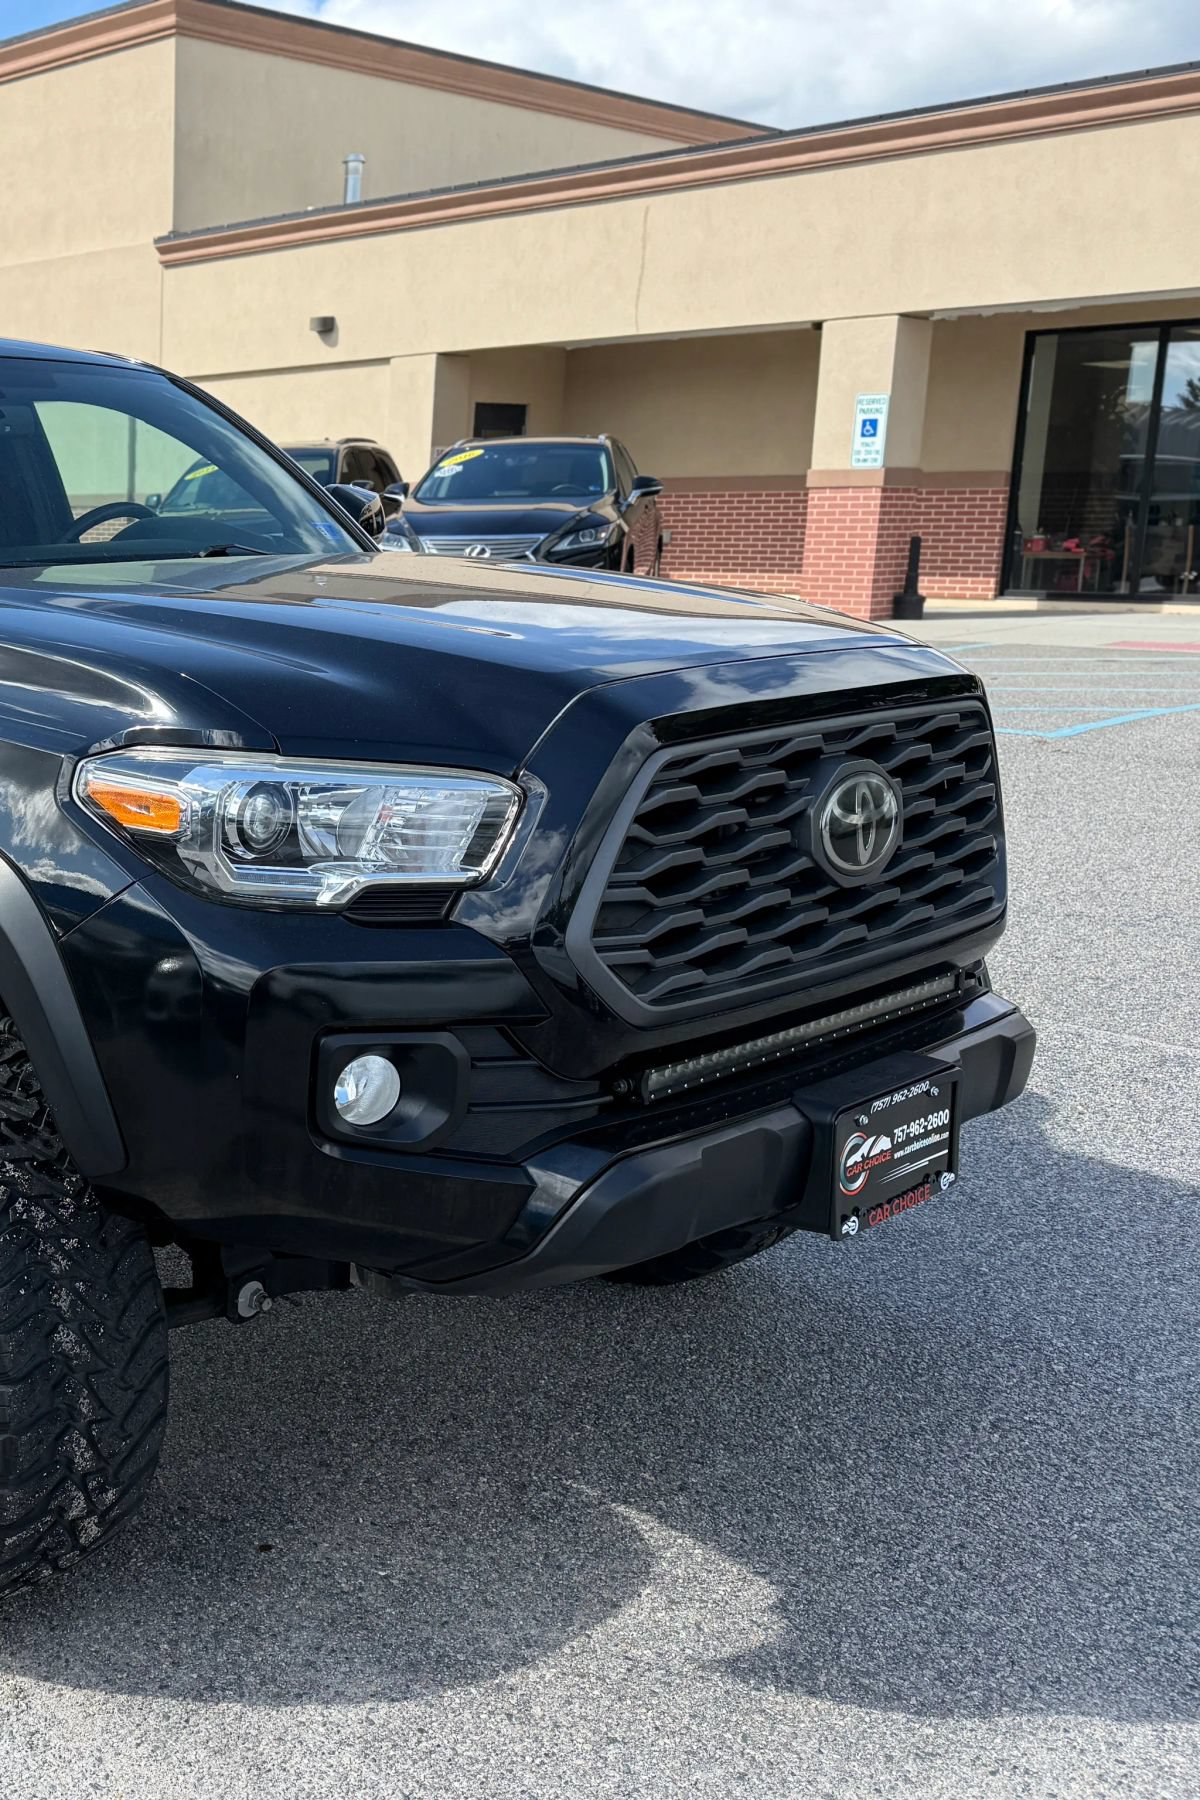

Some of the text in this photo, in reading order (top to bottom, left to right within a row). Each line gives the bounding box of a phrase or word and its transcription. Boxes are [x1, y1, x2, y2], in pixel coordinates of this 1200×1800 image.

[858, 407, 884, 415] PARKING
[870, 1081, 930, 1114] (757) 962-2600
[893, 1108, 950, 1145] 757-962-2600
[893, 1131, 950, 1160] www.carchoiceonline.com
[846, 1150, 892, 1177] CAR CHOICE
[868, 1183, 932, 1226] CAR CHOICE
